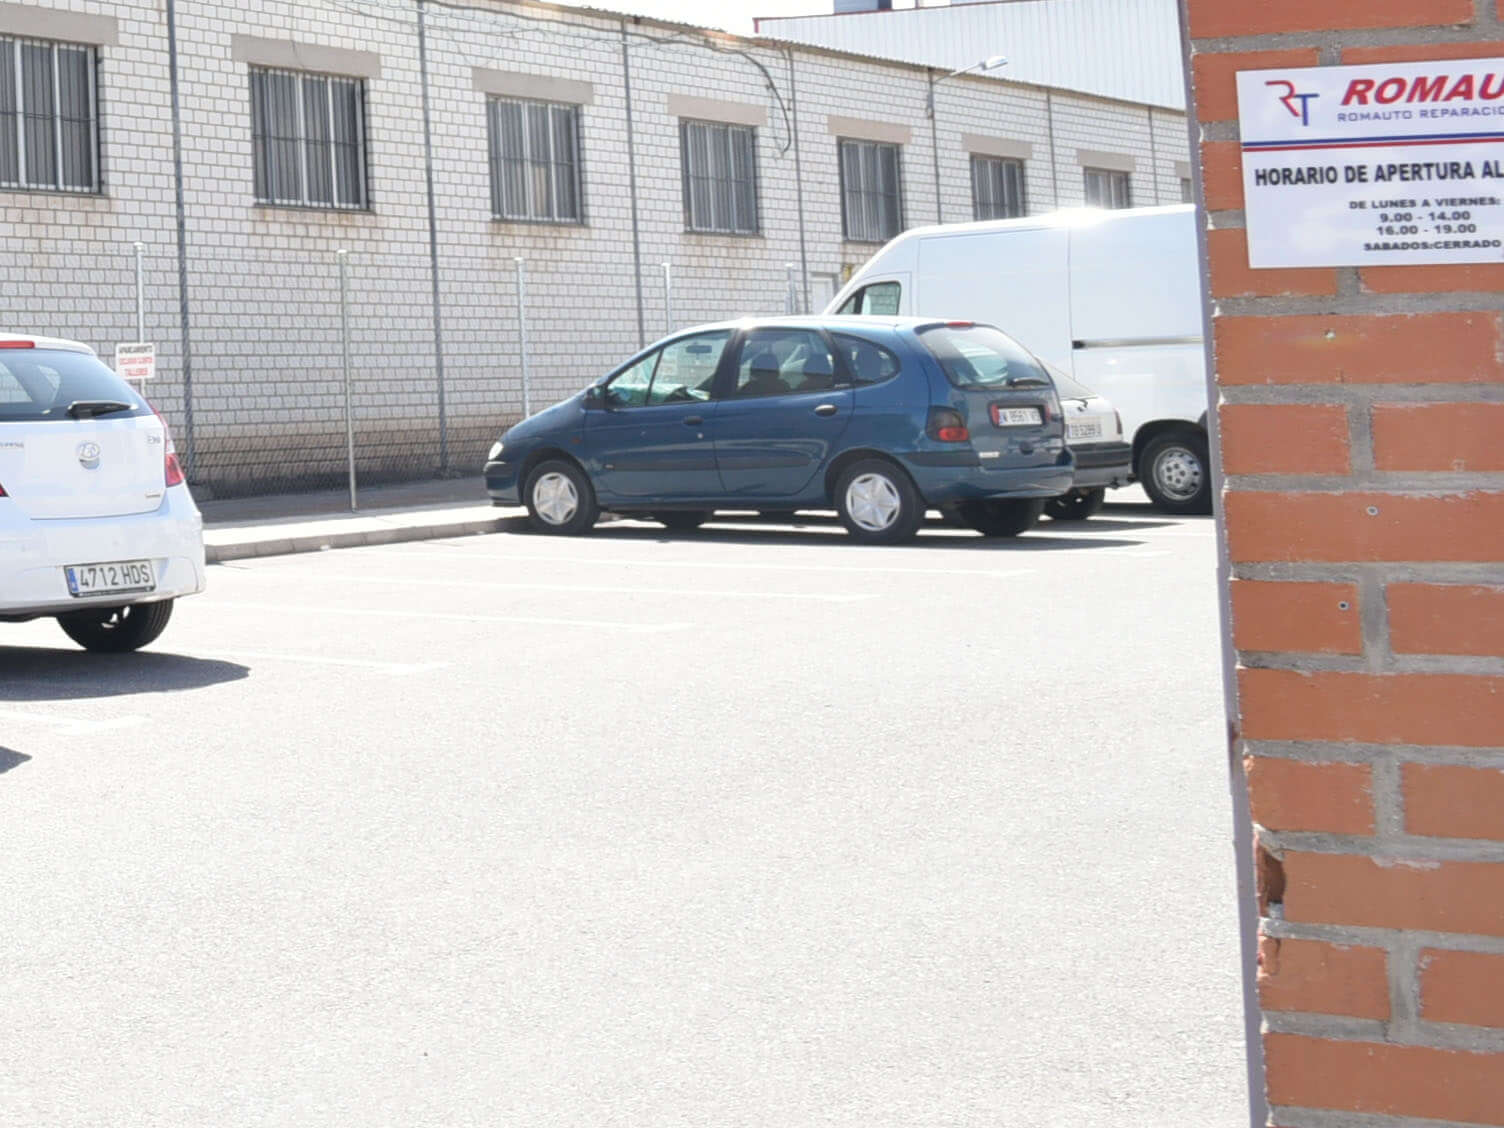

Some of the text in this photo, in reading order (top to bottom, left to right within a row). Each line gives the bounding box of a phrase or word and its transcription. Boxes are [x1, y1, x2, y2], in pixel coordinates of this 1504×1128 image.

[1339, 73, 1504, 106] ROMAU
[1337, 110, 1413, 122] ROMAUTO
[1255, 166, 1338, 186] HORARIO
[1344, 165, 1368, 183] DE
[1374, 161, 1474, 182] APERTURA
[1349, 201, 1366, 210] DE
[1371, 199, 1416, 209] LUNES
[1421, 199, 1431, 208] A
[1429, 210, 1471, 222] 14.00
[80, 564, 150, 588] 4712 HDS
